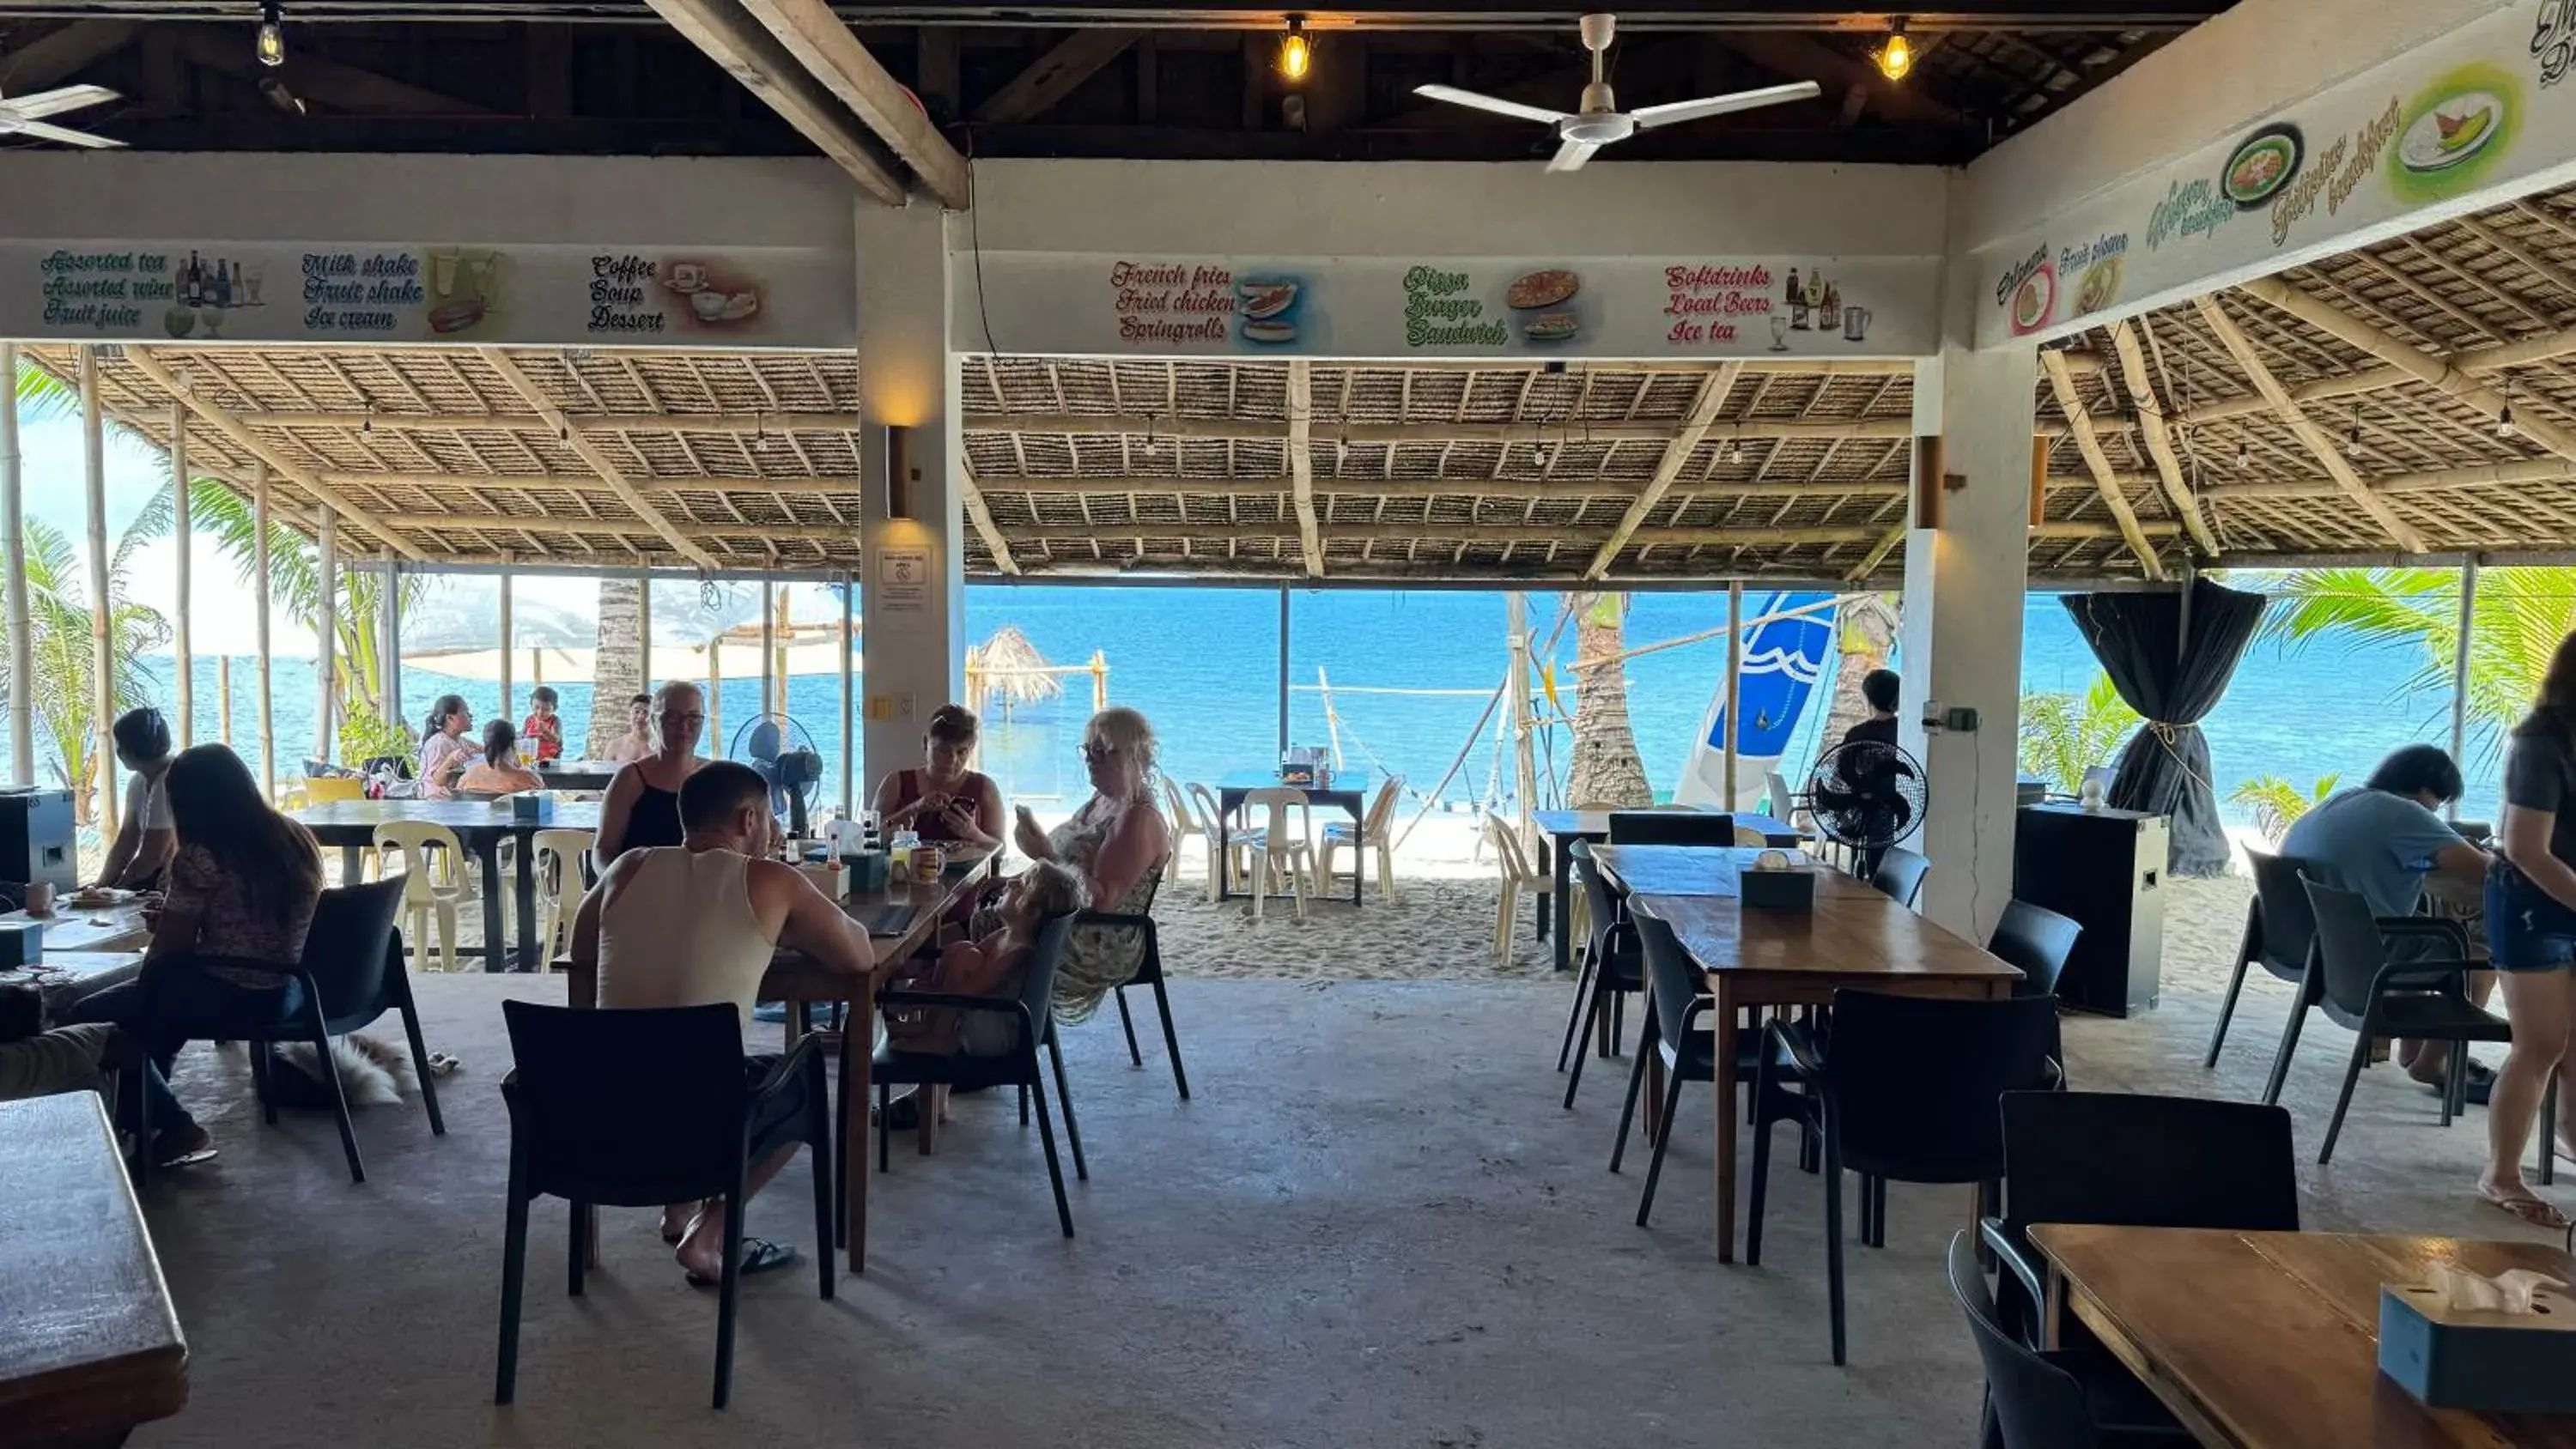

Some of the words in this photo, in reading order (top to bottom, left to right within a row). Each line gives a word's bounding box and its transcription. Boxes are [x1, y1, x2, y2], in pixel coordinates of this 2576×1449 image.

[40, 250, 134, 275] Assorted
[137, 253, 167, 275] tea
[301, 253, 356, 276] Milk
[361, 252, 420, 276] shake
[591, 256, 658, 285] Coffee
[1110, 261, 1186, 288] French
[1190, 265, 1231, 290] fries
[42, 276, 126, 300] Assorted
[132, 279, 174, 300] wine
[302, 276, 364, 303] Fruit
[366, 279, 425, 304] shake
[589, 279, 644, 305] Soup
[1402, 265, 1469, 295] Pizza
[1665, 264, 1771, 292] Softdrinks
[42, 298, 96, 326] Fruit
[94, 304, 142, 329] juice
[1115, 288, 1169, 312] Fried
[1173, 289, 1236, 313] chicken
[1404, 291, 1484, 322] Burger
[1663, 293, 1720, 315] Local
[1723, 290, 1771, 315] Beers
[303, 305, 337, 330] Ice
[338, 310, 398, 330] cream
[587, 304, 664, 333] Dessert
[1119, 315, 1226, 343] Springrolls
[1668, 318, 1704, 342] Ice
[1709, 320, 1737, 342] tea
